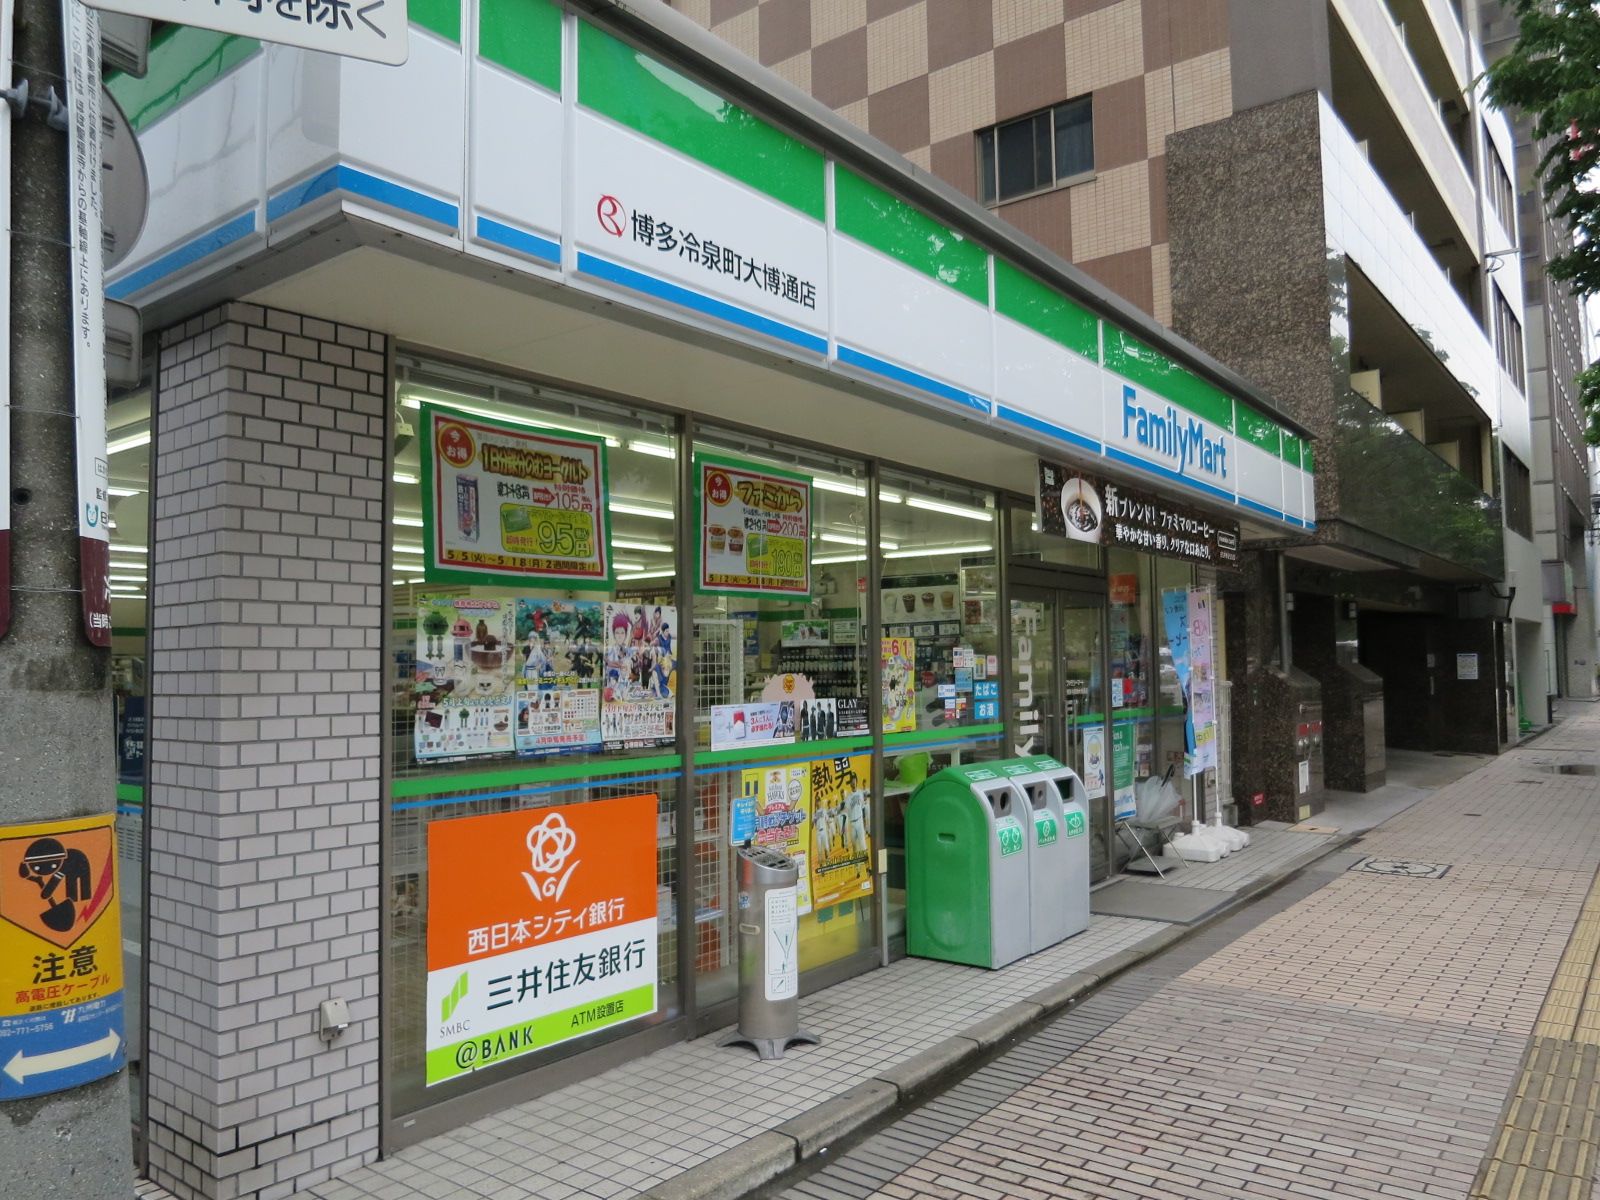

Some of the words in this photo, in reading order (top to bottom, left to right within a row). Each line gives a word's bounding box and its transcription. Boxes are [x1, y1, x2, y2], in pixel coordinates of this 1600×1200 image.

[631, 209, 817, 311] 博多冷泉町大博通店
[1122, 384, 1228, 479] FamilyMart
[555, 492, 581, 512] 105
[537, 520, 575, 554] 95
[1159, 510, 1216, 542] ファミマのコーヒー
[837, 698, 859, 709] GLAY
[975, 683, 998, 696] たばこ
[978, 703, 995, 717] お酒
[467, 896, 626, 956] 西日本シティ銀行
[32, 944, 99, 986] 注意
[486, 938, 647, 1012] 三井住友銀行
[15, 974, 111, 1005] 高電圧ケーブル
[439, 1018, 472, 1039] SMBC
[570, 999, 626, 1029] ATM設置店
[455, 1024, 534, 1070] @BANK
